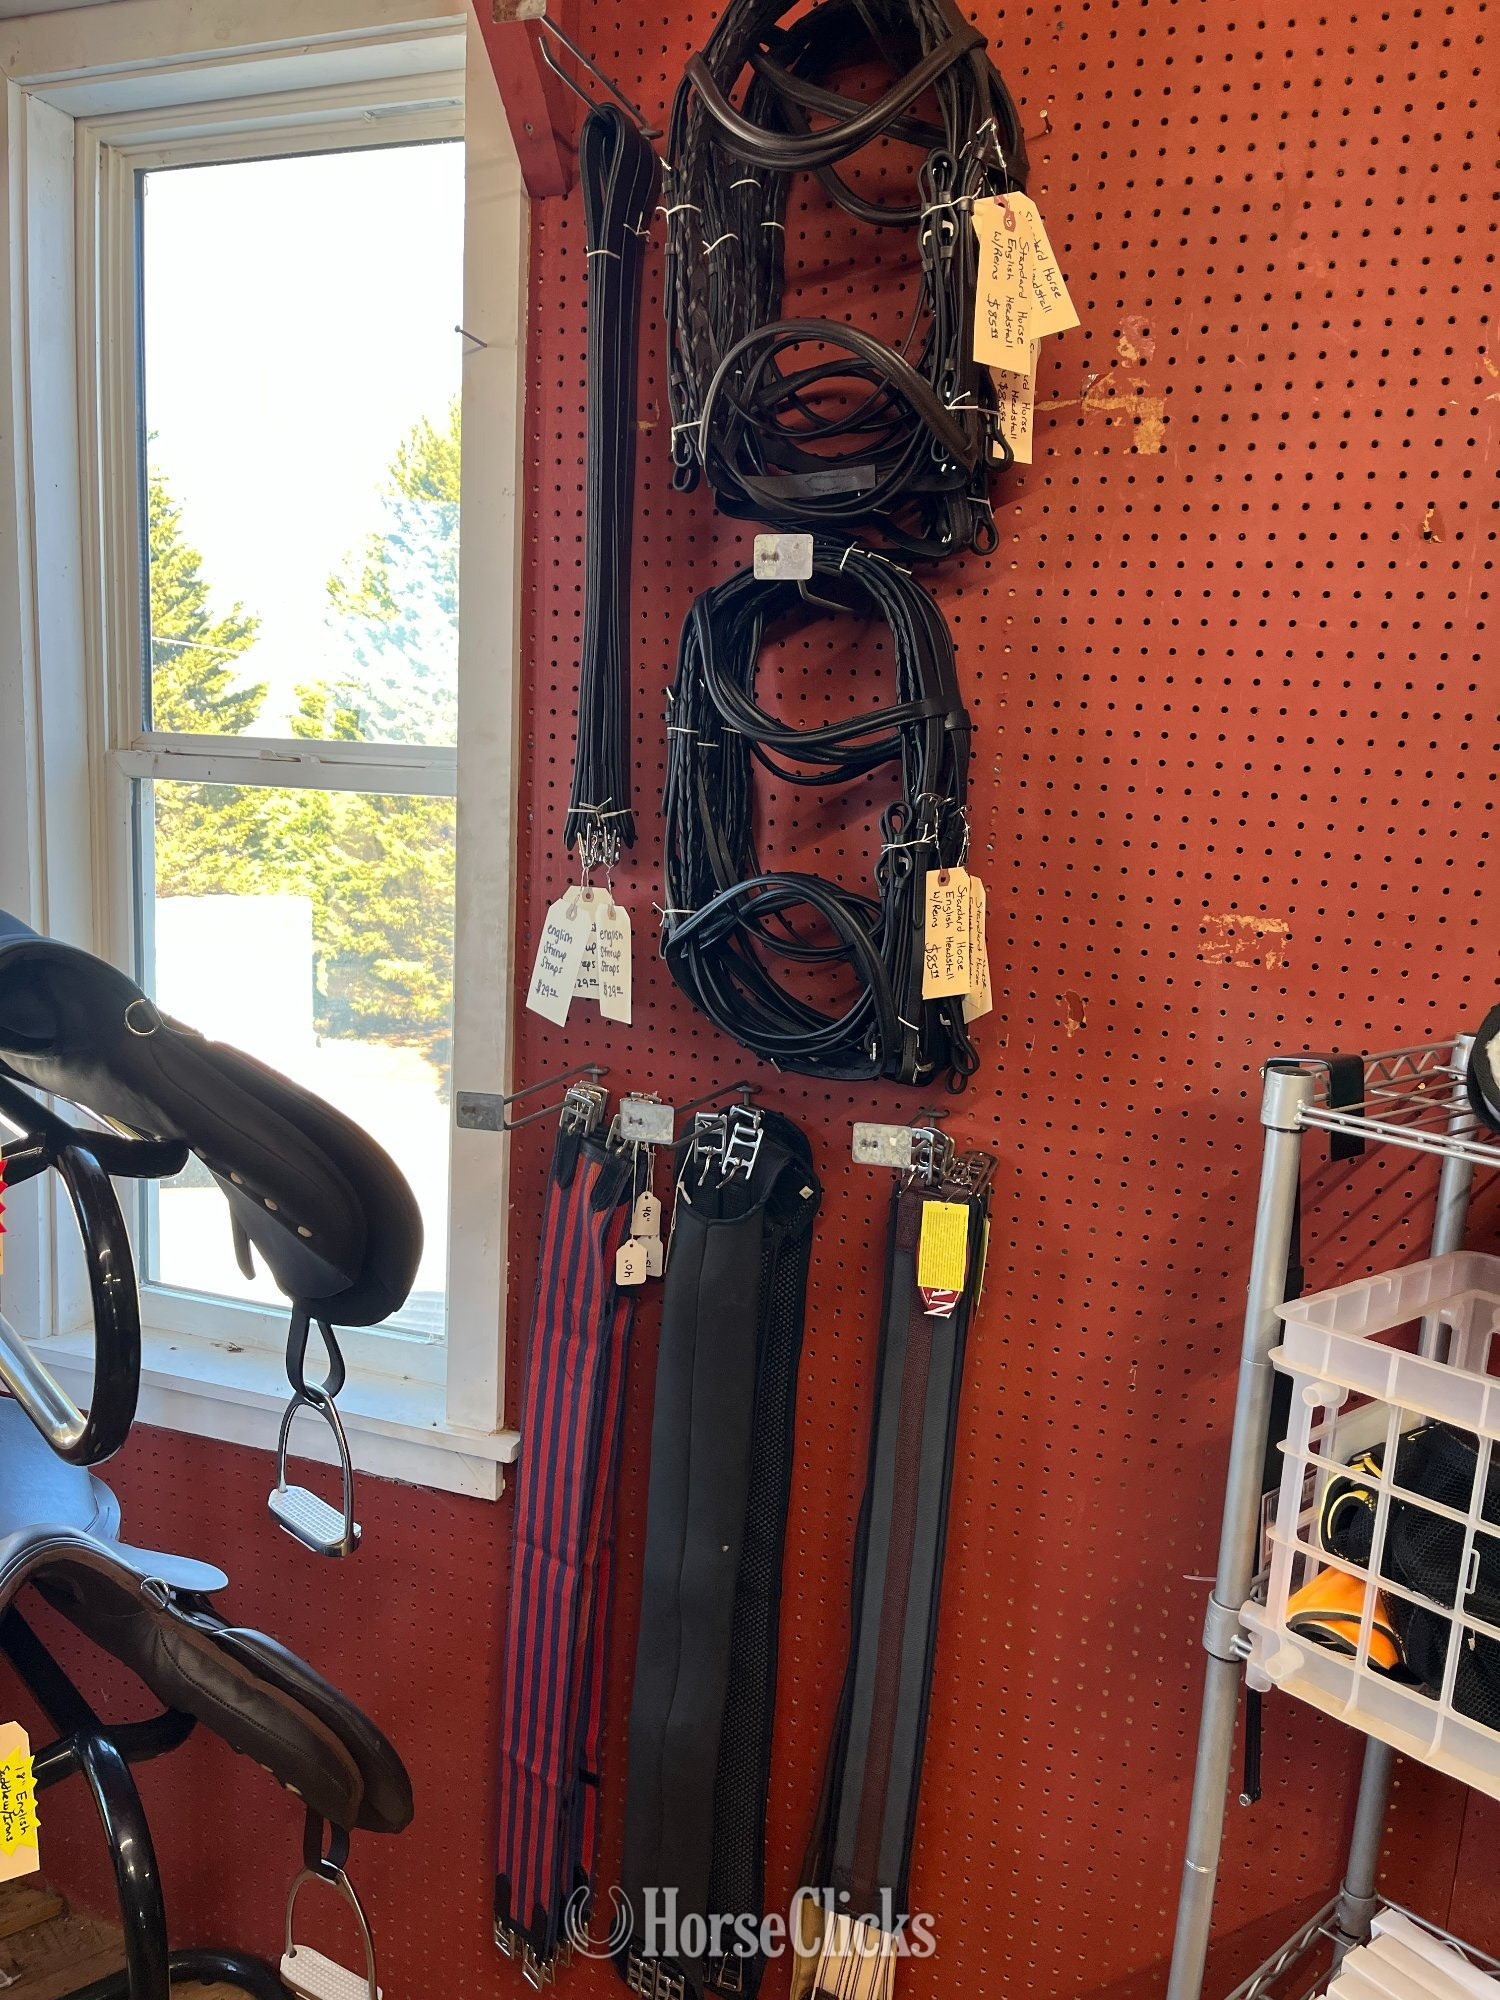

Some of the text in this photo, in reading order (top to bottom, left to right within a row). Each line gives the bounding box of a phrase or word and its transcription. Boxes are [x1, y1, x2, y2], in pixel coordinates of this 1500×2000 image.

[1004, 238, 1016, 348] English Headstall
[1017, 237, 1030, 345] Standard Horse
[1043, 267, 1061, 300] Horse
[1010, 389, 1020, 440] Headstall
[1020, 402, 1031, 434] Horse
[942, 890, 955, 981] English Headstall
[956, 885, 968, 971] Standard Horse
[12, 1790, 31, 1836] English
